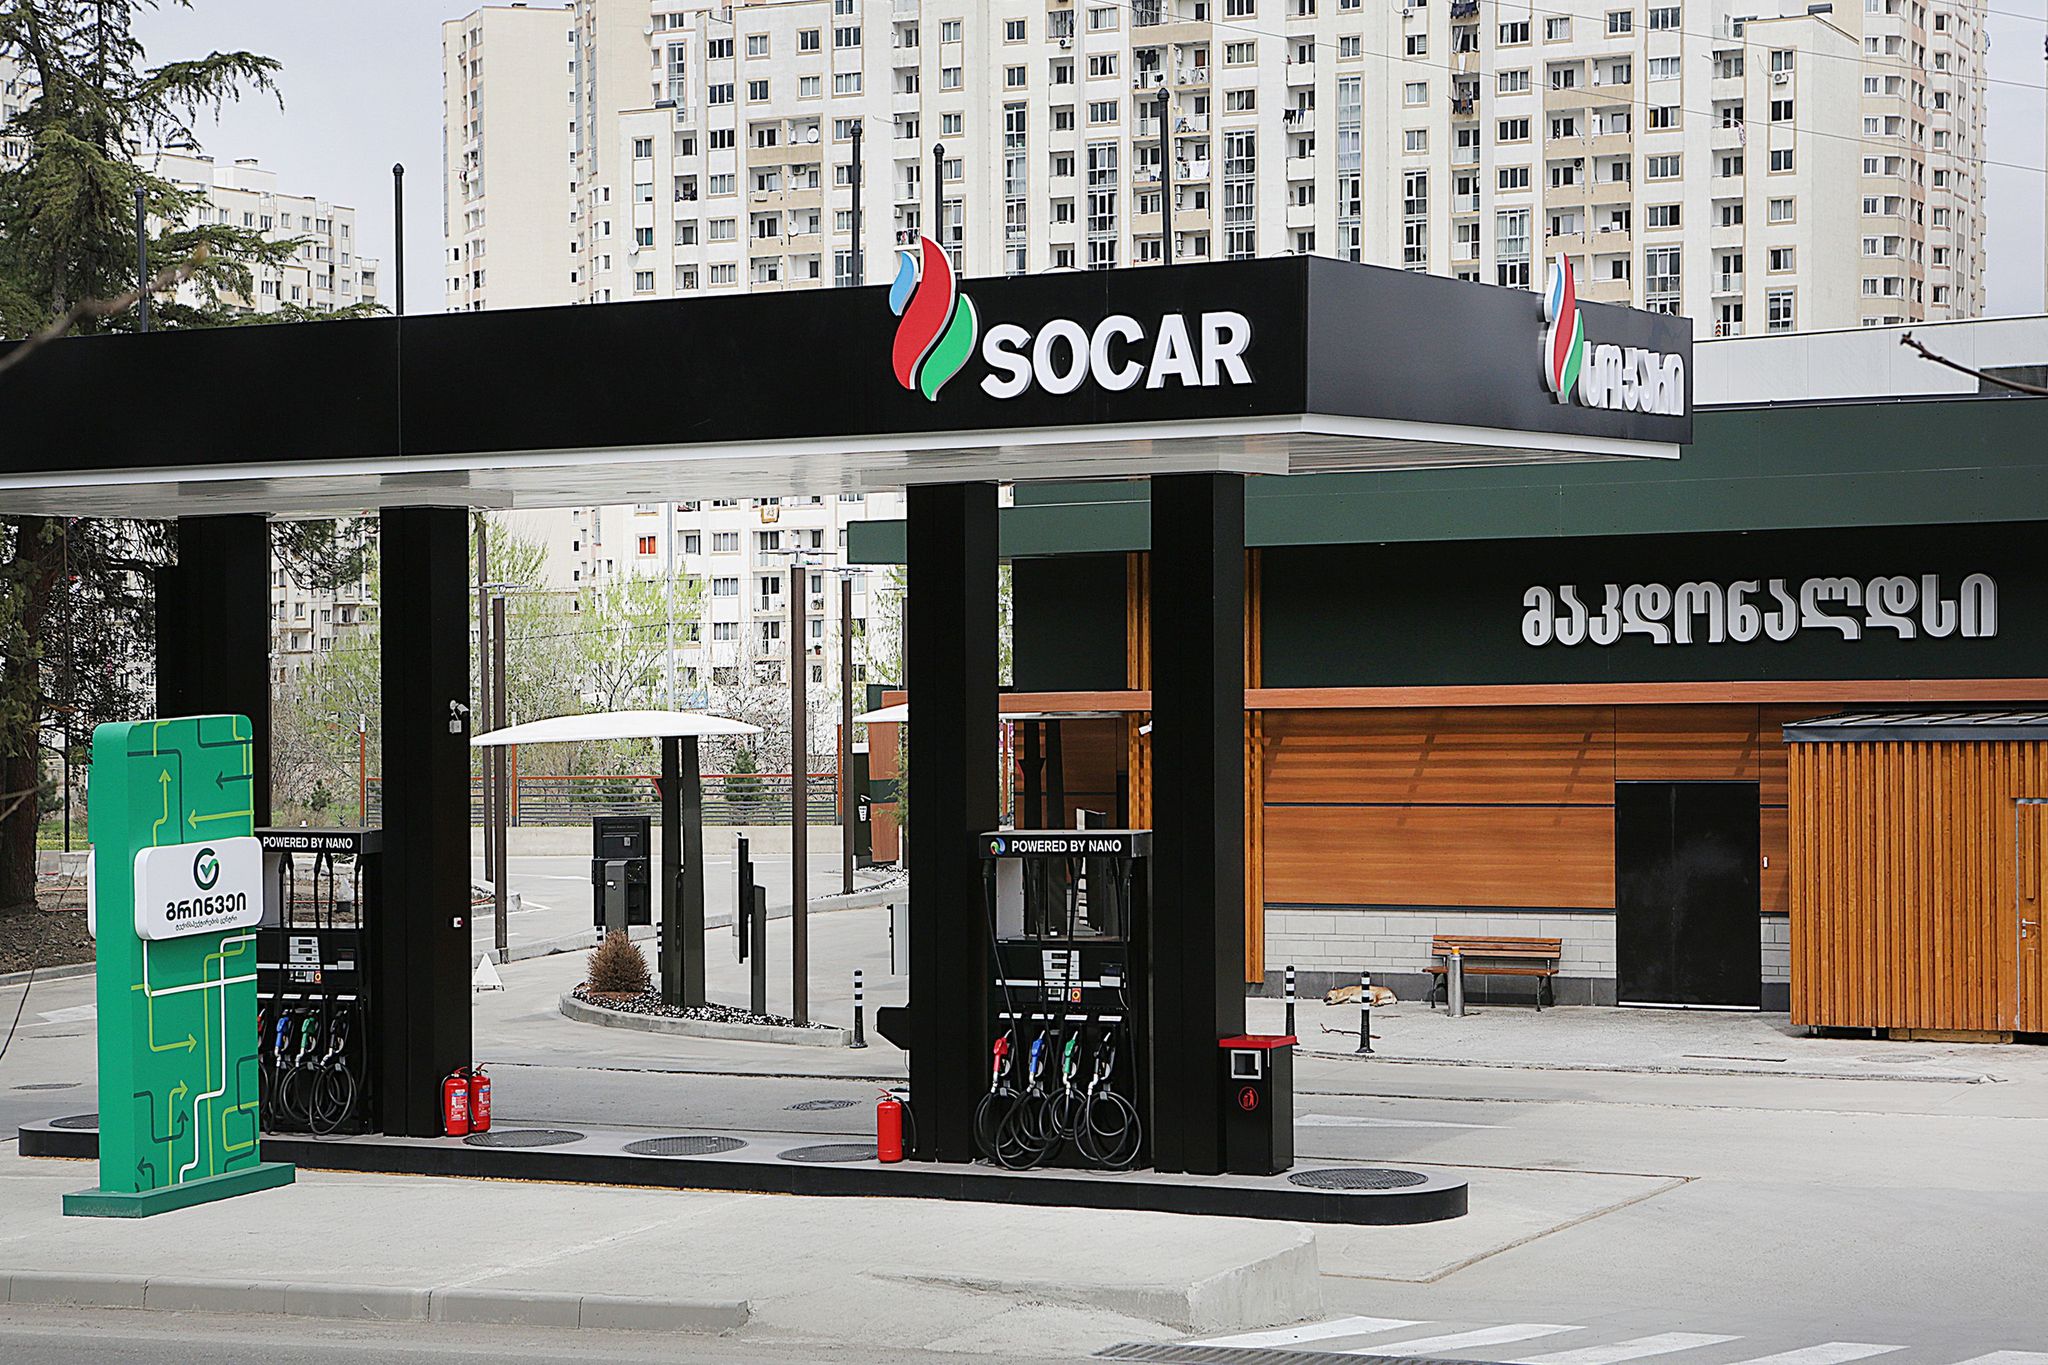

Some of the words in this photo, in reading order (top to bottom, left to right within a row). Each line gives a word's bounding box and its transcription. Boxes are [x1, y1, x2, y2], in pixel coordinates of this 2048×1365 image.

[980, 310, 1253, 400] SOCAR
[1577, 340, 1686, 417] სოკარი
[1521, 572, 1999, 646] მაკდონალდსი
[263, 836, 309, 849] POWERED
[310, 837, 324, 849] BY
[325, 837, 353, 849] NANO
[1011, 839, 1068, 853] POWERED
[1070, 839, 1086, 853] BY
[1088, 839, 1122, 853] NANO
[165, 891, 247, 922] გრინვეი
